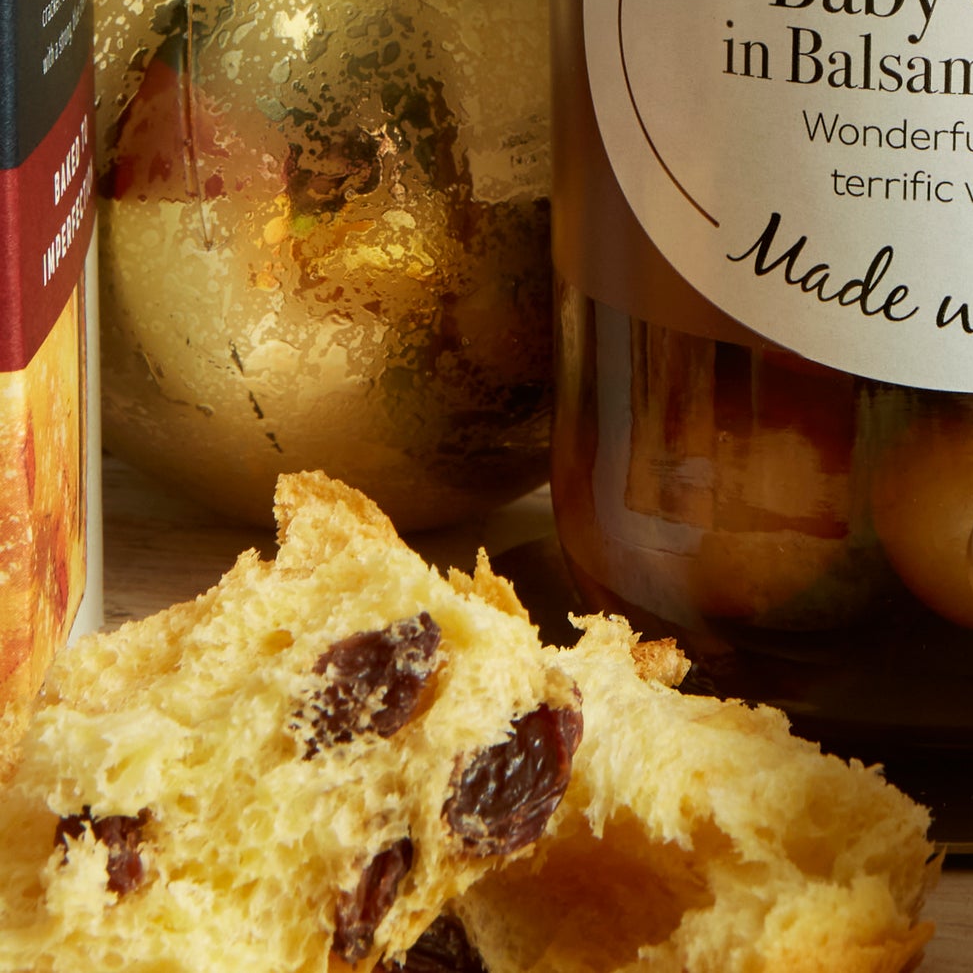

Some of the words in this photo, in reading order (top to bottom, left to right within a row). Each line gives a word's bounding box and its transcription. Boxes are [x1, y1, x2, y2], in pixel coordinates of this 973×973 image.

[723, 20, 772, 80] in
[54, 135, 79, 206] BAKED
[831, 169, 953, 203] terrific
[724, 212, 919, 325] Made
